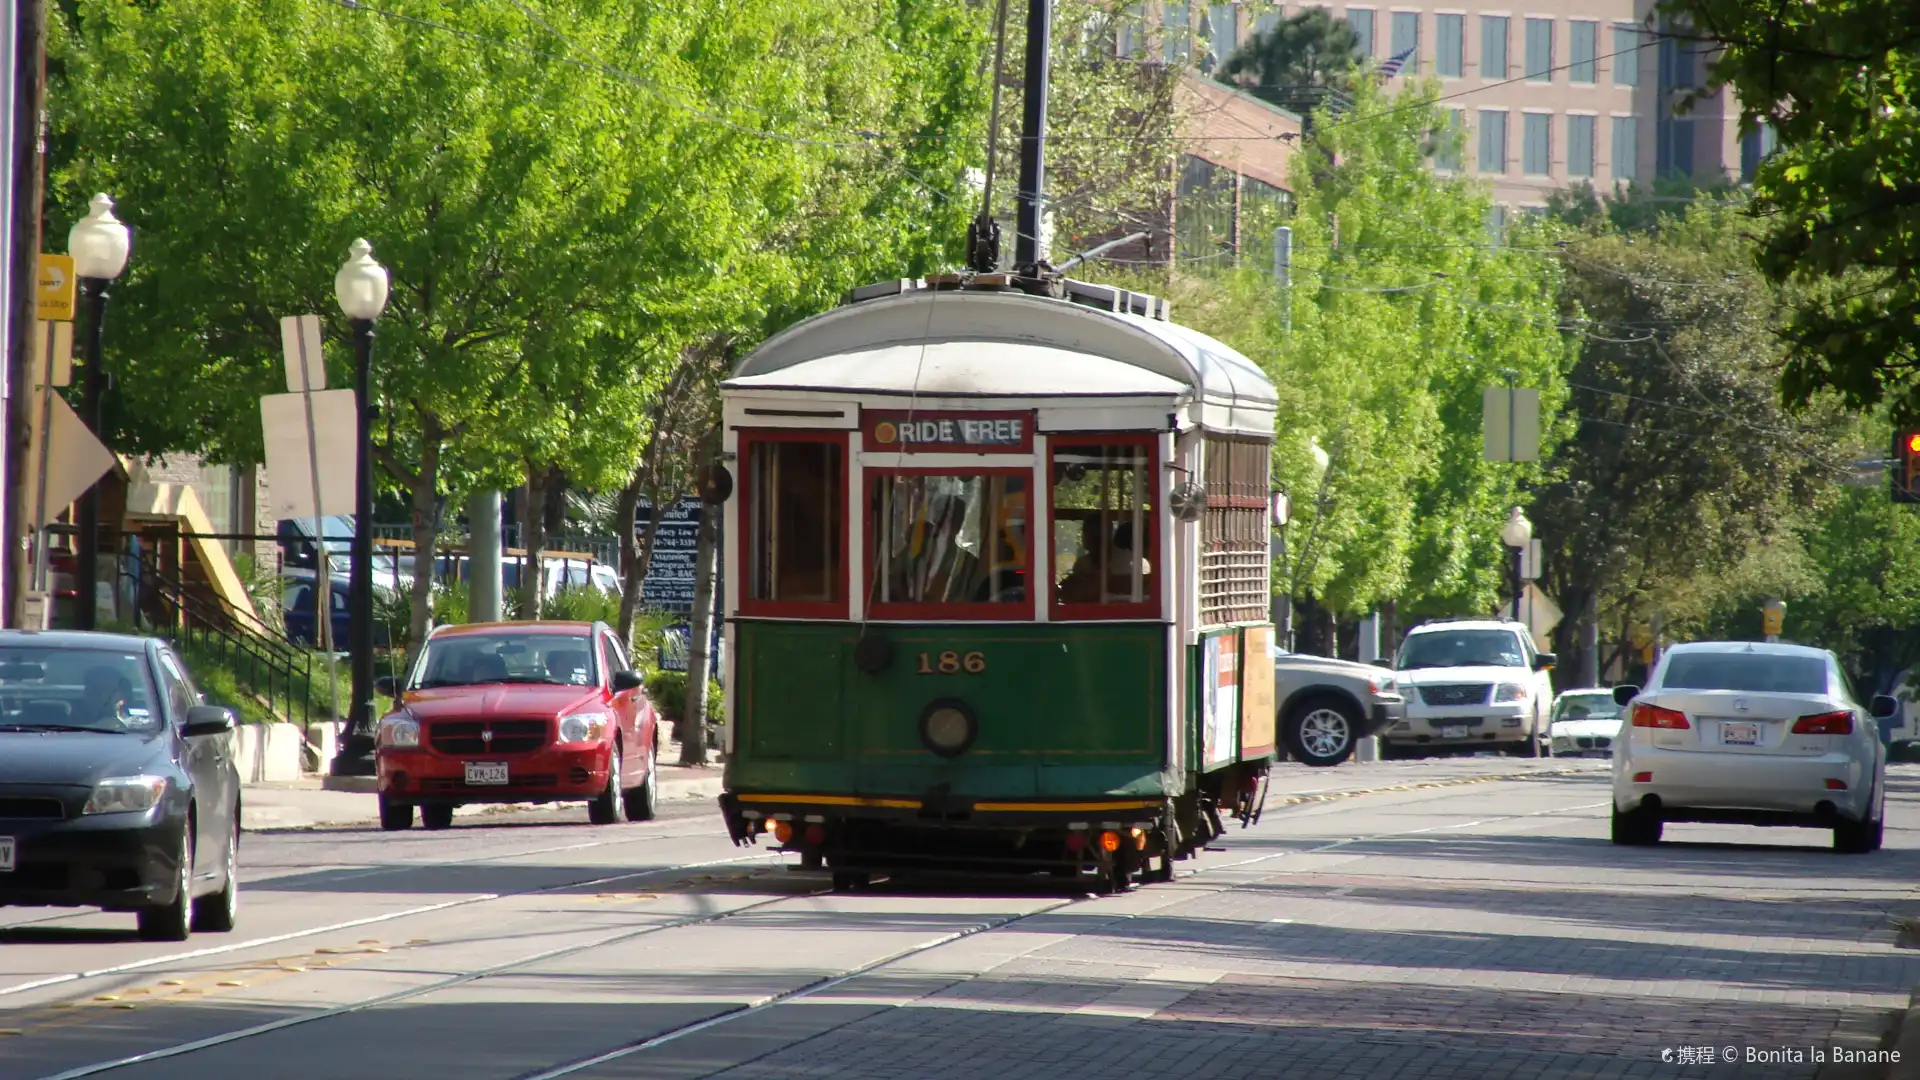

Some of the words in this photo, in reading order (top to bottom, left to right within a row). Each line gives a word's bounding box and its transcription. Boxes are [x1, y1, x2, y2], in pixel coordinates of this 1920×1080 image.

[899, 421, 954, 443] RIDE
[965, 419, 1022, 441] FREE
[917, 651, 986, 674] 186
